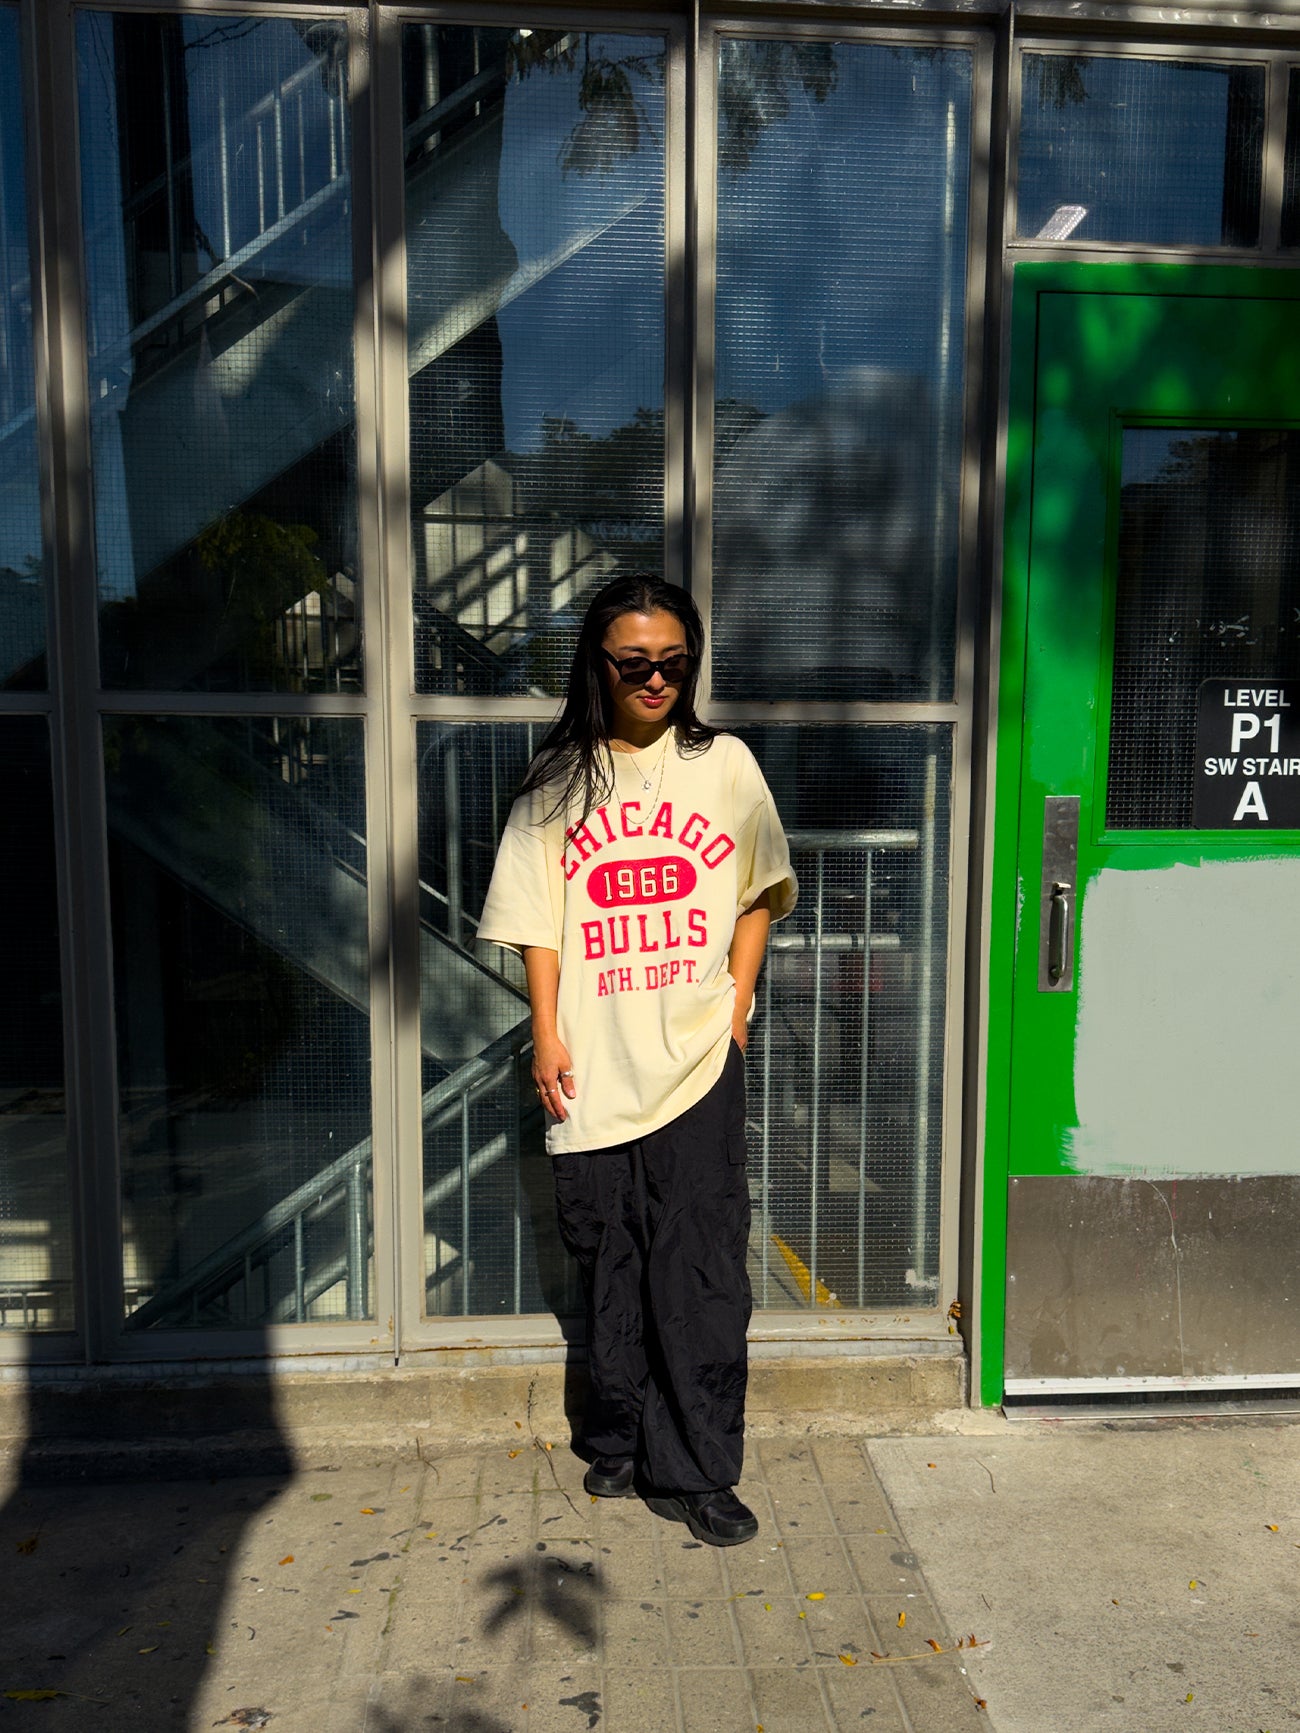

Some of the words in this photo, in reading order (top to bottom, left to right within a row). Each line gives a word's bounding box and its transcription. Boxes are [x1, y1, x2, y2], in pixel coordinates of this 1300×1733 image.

[1224, 688, 1291, 707] LEVEL
[1231, 712, 1280, 753] P1
[1204, 757, 1238, 776] SW
[1232, 781, 1269, 821] A
[603, 864, 679, 901] 1966
[580, 908, 708, 960] BULLS
[597, 967, 640, 997] ATH.
[645, 959, 700, 991] DEPT.
